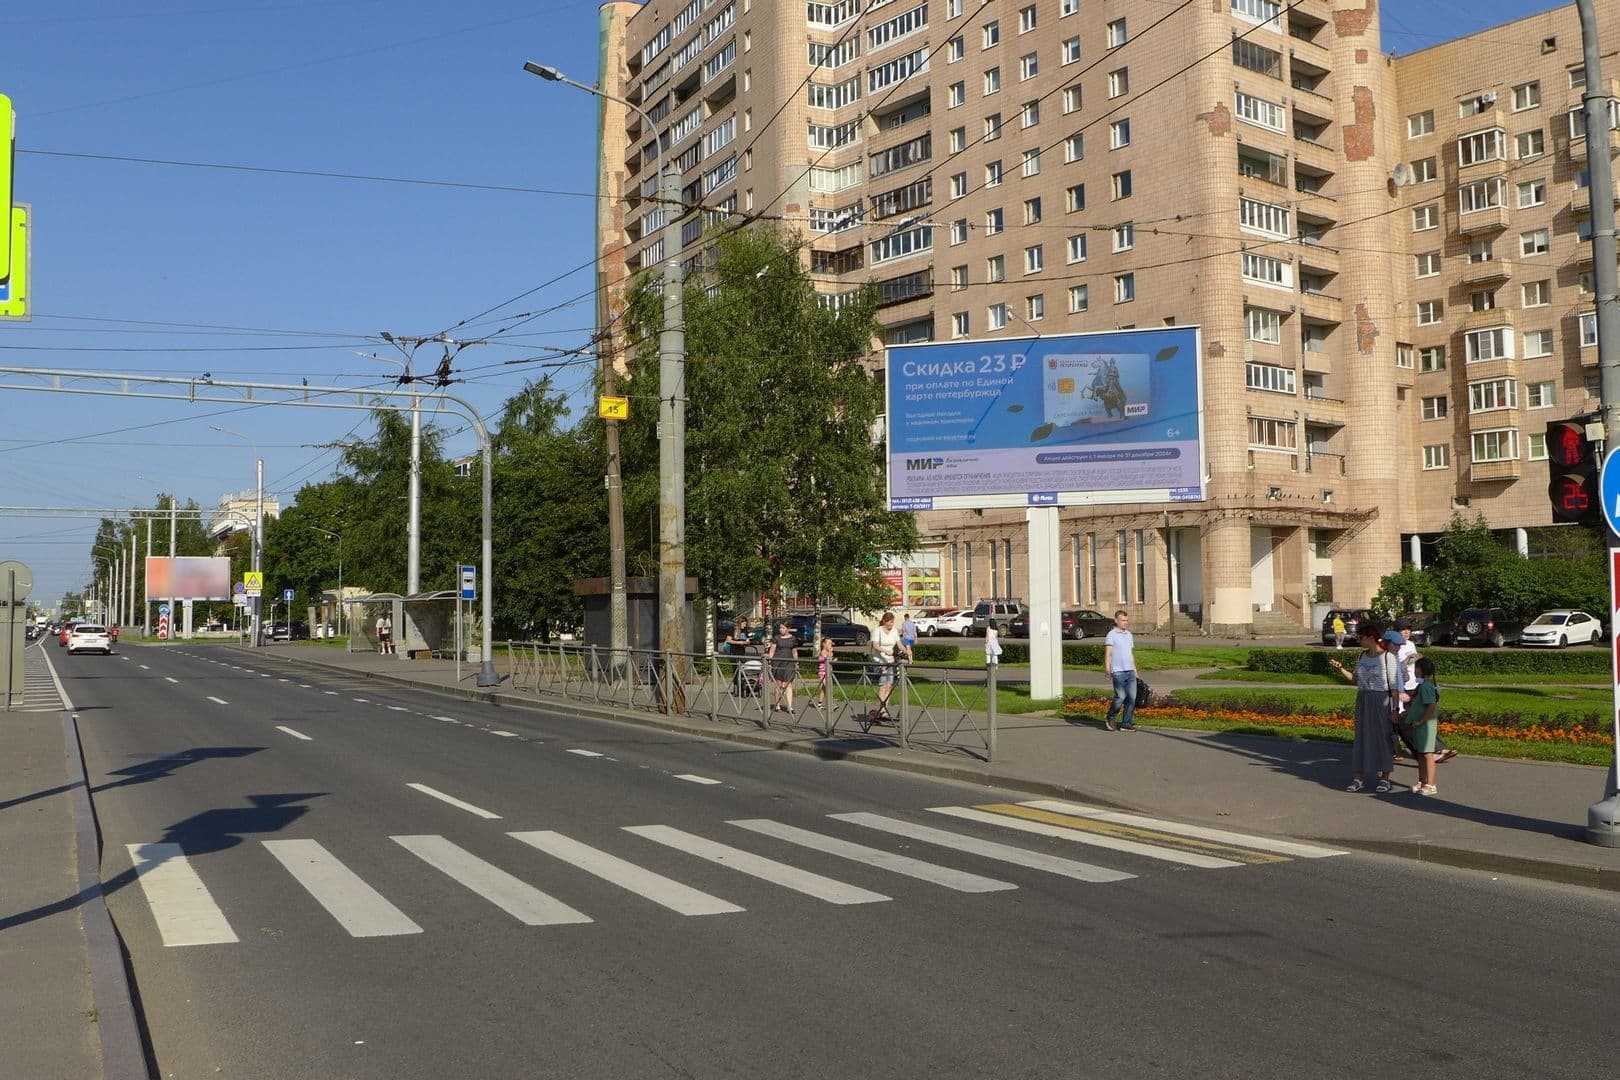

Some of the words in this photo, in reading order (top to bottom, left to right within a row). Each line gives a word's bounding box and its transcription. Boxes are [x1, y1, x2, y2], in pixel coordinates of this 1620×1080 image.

[903, 360, 976, 377] Скидка
[979, 354, 1006, 373] 23
[905, 383, 924, 393] при
[925, 381, 960, 391] оплате
[962, 380, 974, 388] по
[976, 377, 1014, 387] Единой
[905, 391, 933, 402] карте
[935, 389, 1001, 400] петербуржца
[608, 405, 619, 414] 15
[1127, 405, 1146, 414] МИР
[1167, 428, 1180, 438] 6+
[906, 457, 944, 471] МИР
